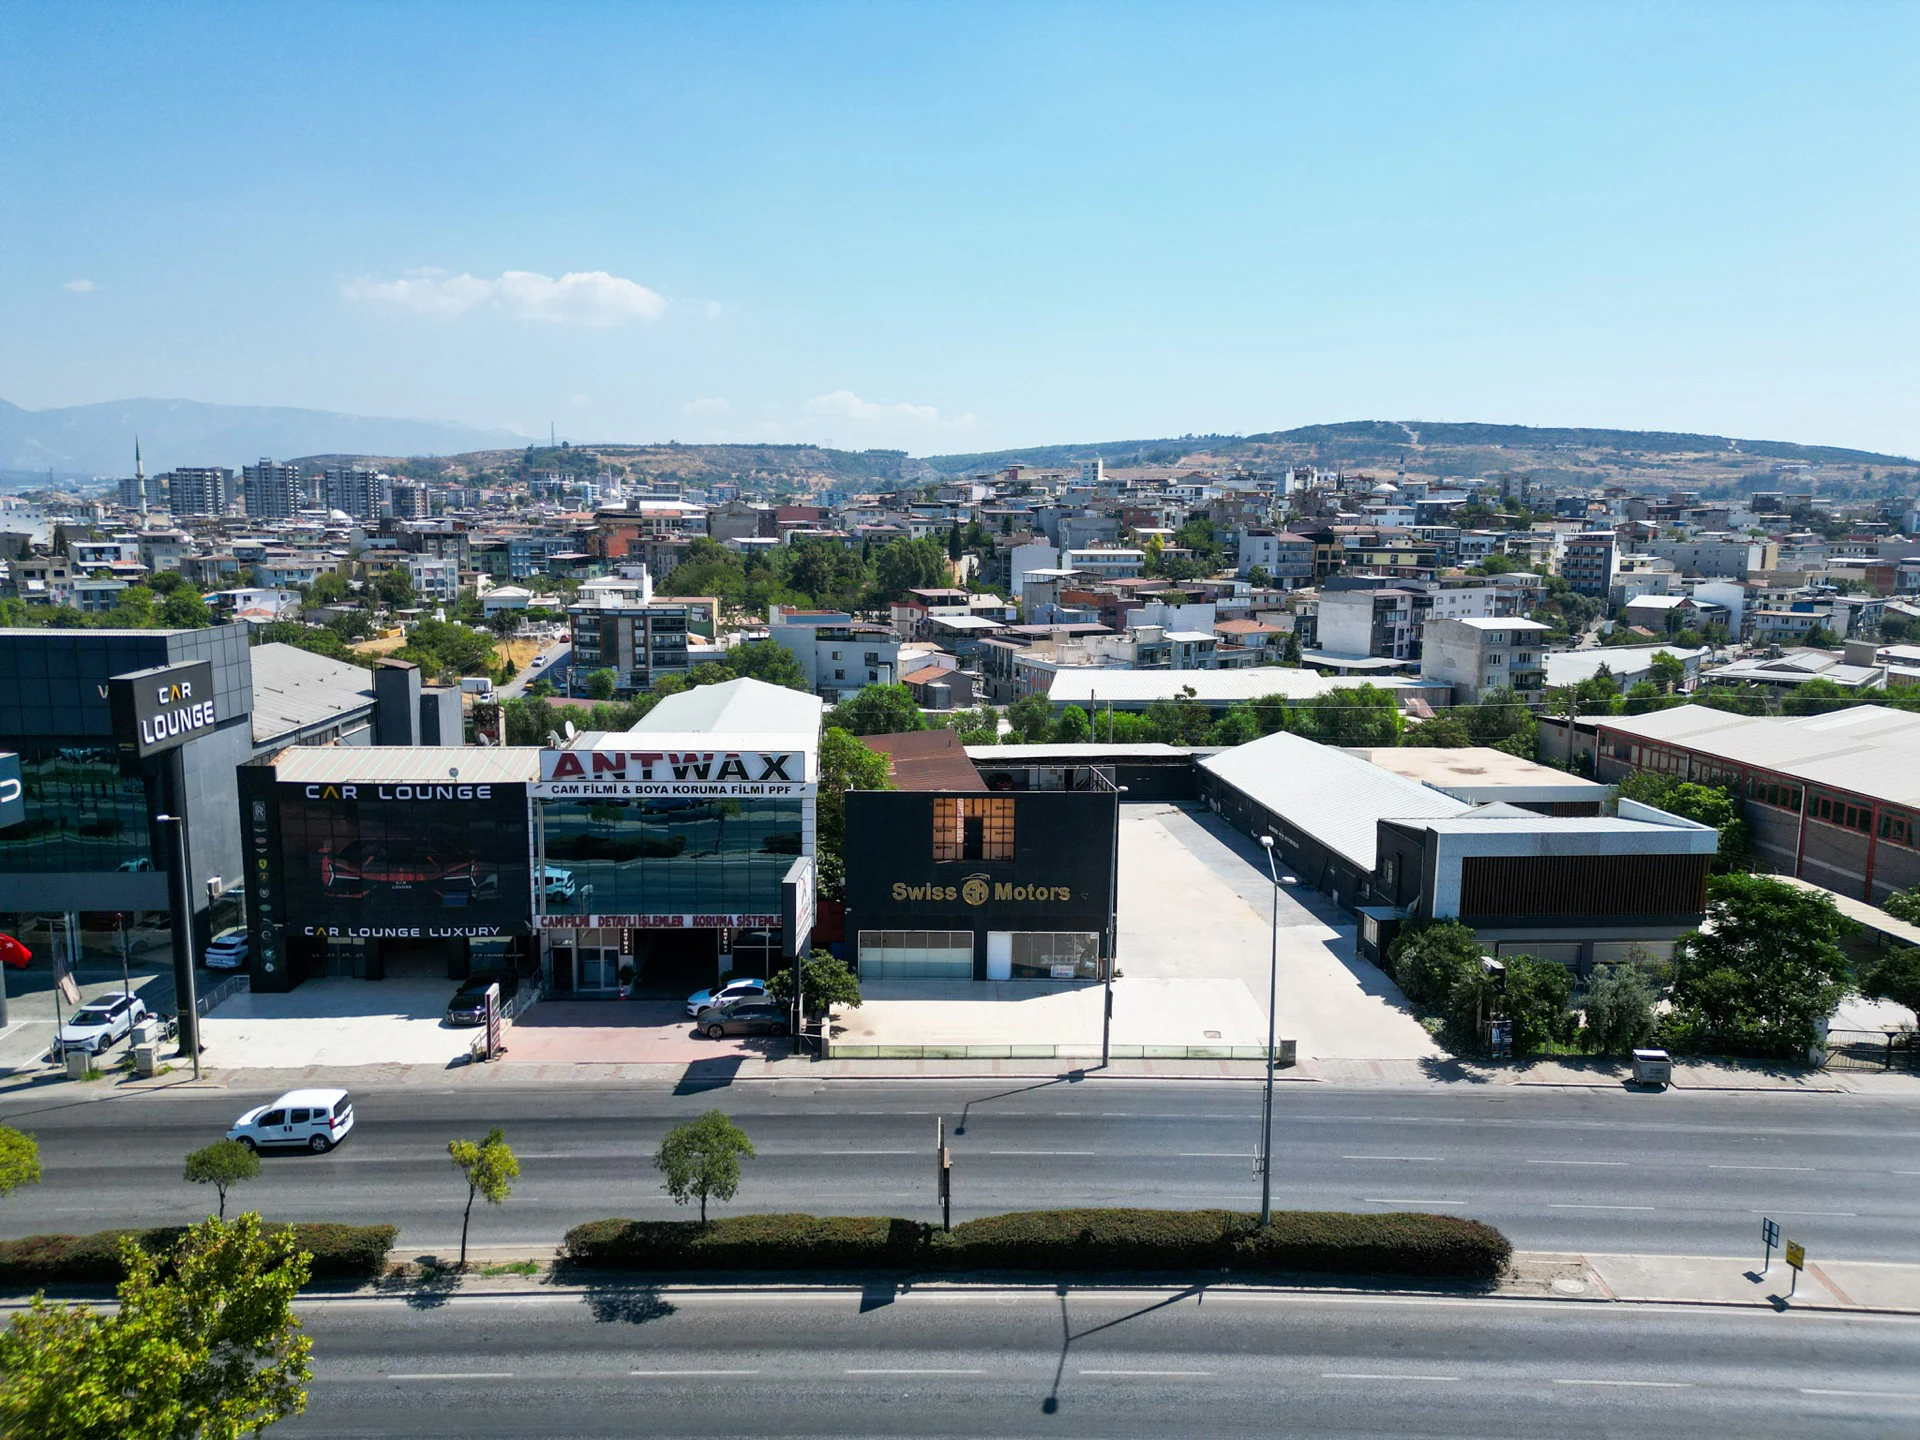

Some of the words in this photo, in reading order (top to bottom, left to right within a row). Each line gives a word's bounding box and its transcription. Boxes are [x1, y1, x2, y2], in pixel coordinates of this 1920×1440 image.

[157, 682, 192, 704] CAR
[142, 700, 215, 744] LOUNGE
[552, 752, 792, 781] ANTWAX
[305, 785, 358, 799] CAR
[378, 785, 492, 800] LOUNGE
[551, 785, 579, 794] CAM
[583, 783, 617, 794] FİLMİ
[621, 785, 631, 794] &
[635, 785, 669, 794] BOYA
[672, 785, 727, 794] KORUMA
[731, 783, 765, 794] FİLMİ
[768, 785, 792, 794] PPF
[892, 882, 958, 901] Swiss
[994, 882, 1071, 901] Motors
[540, 915, 563, 927] CAM
[597, 914, 637, 927] DETAYLI
[692, 915, 734, 927] KORUMA
[736, 913, 782, 927] SİSTEMLE
[304, 926, 339, 936] CAR
[348, 927, 420, 937] LOUNGE
[429, 926, 501, 937] LUXURY
